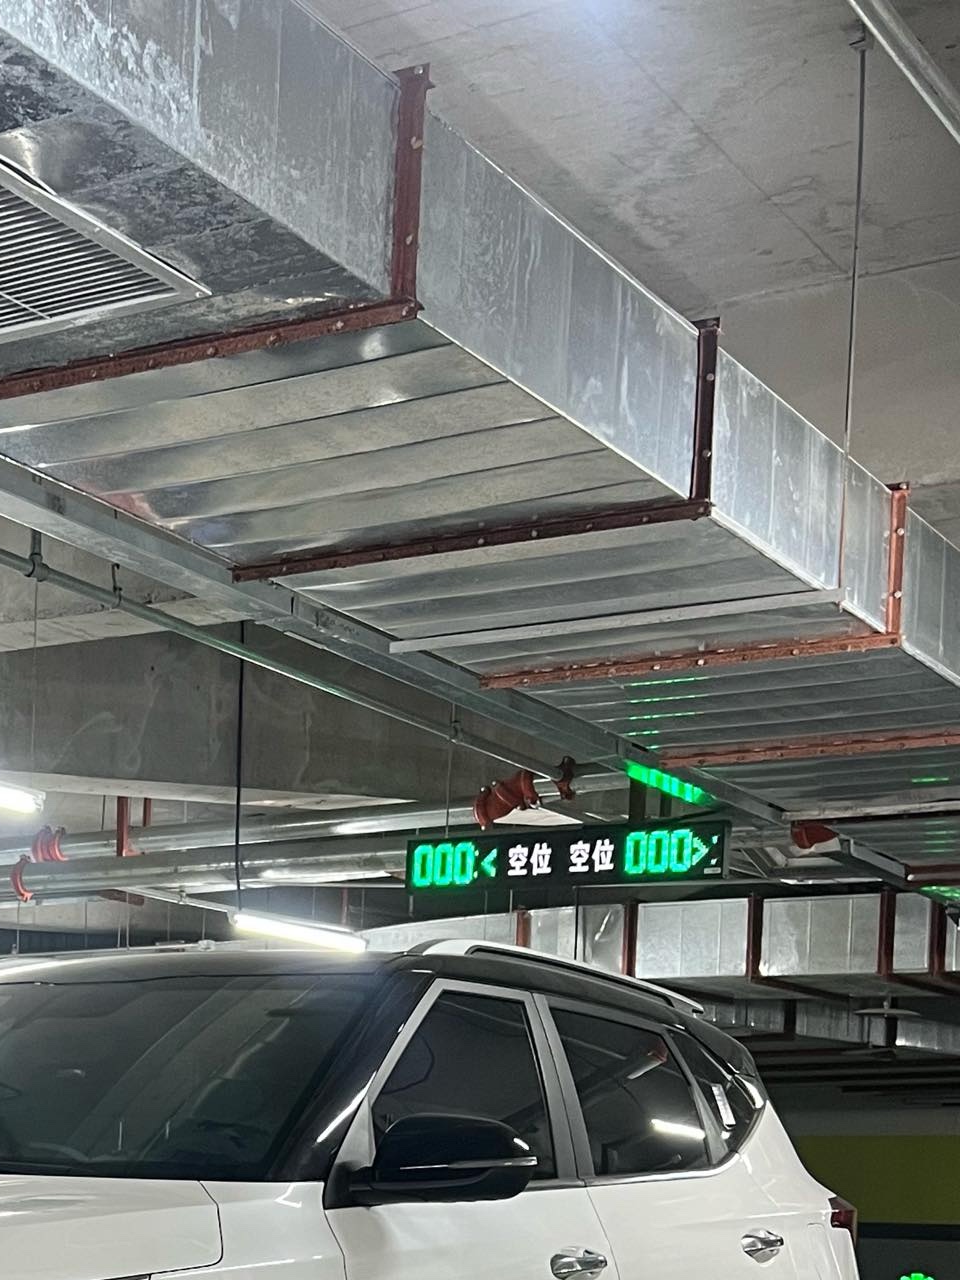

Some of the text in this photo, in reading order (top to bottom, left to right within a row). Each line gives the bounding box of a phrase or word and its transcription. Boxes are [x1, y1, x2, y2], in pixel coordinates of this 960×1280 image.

[413, 829, 693, 887] 000 空位 空位 000
